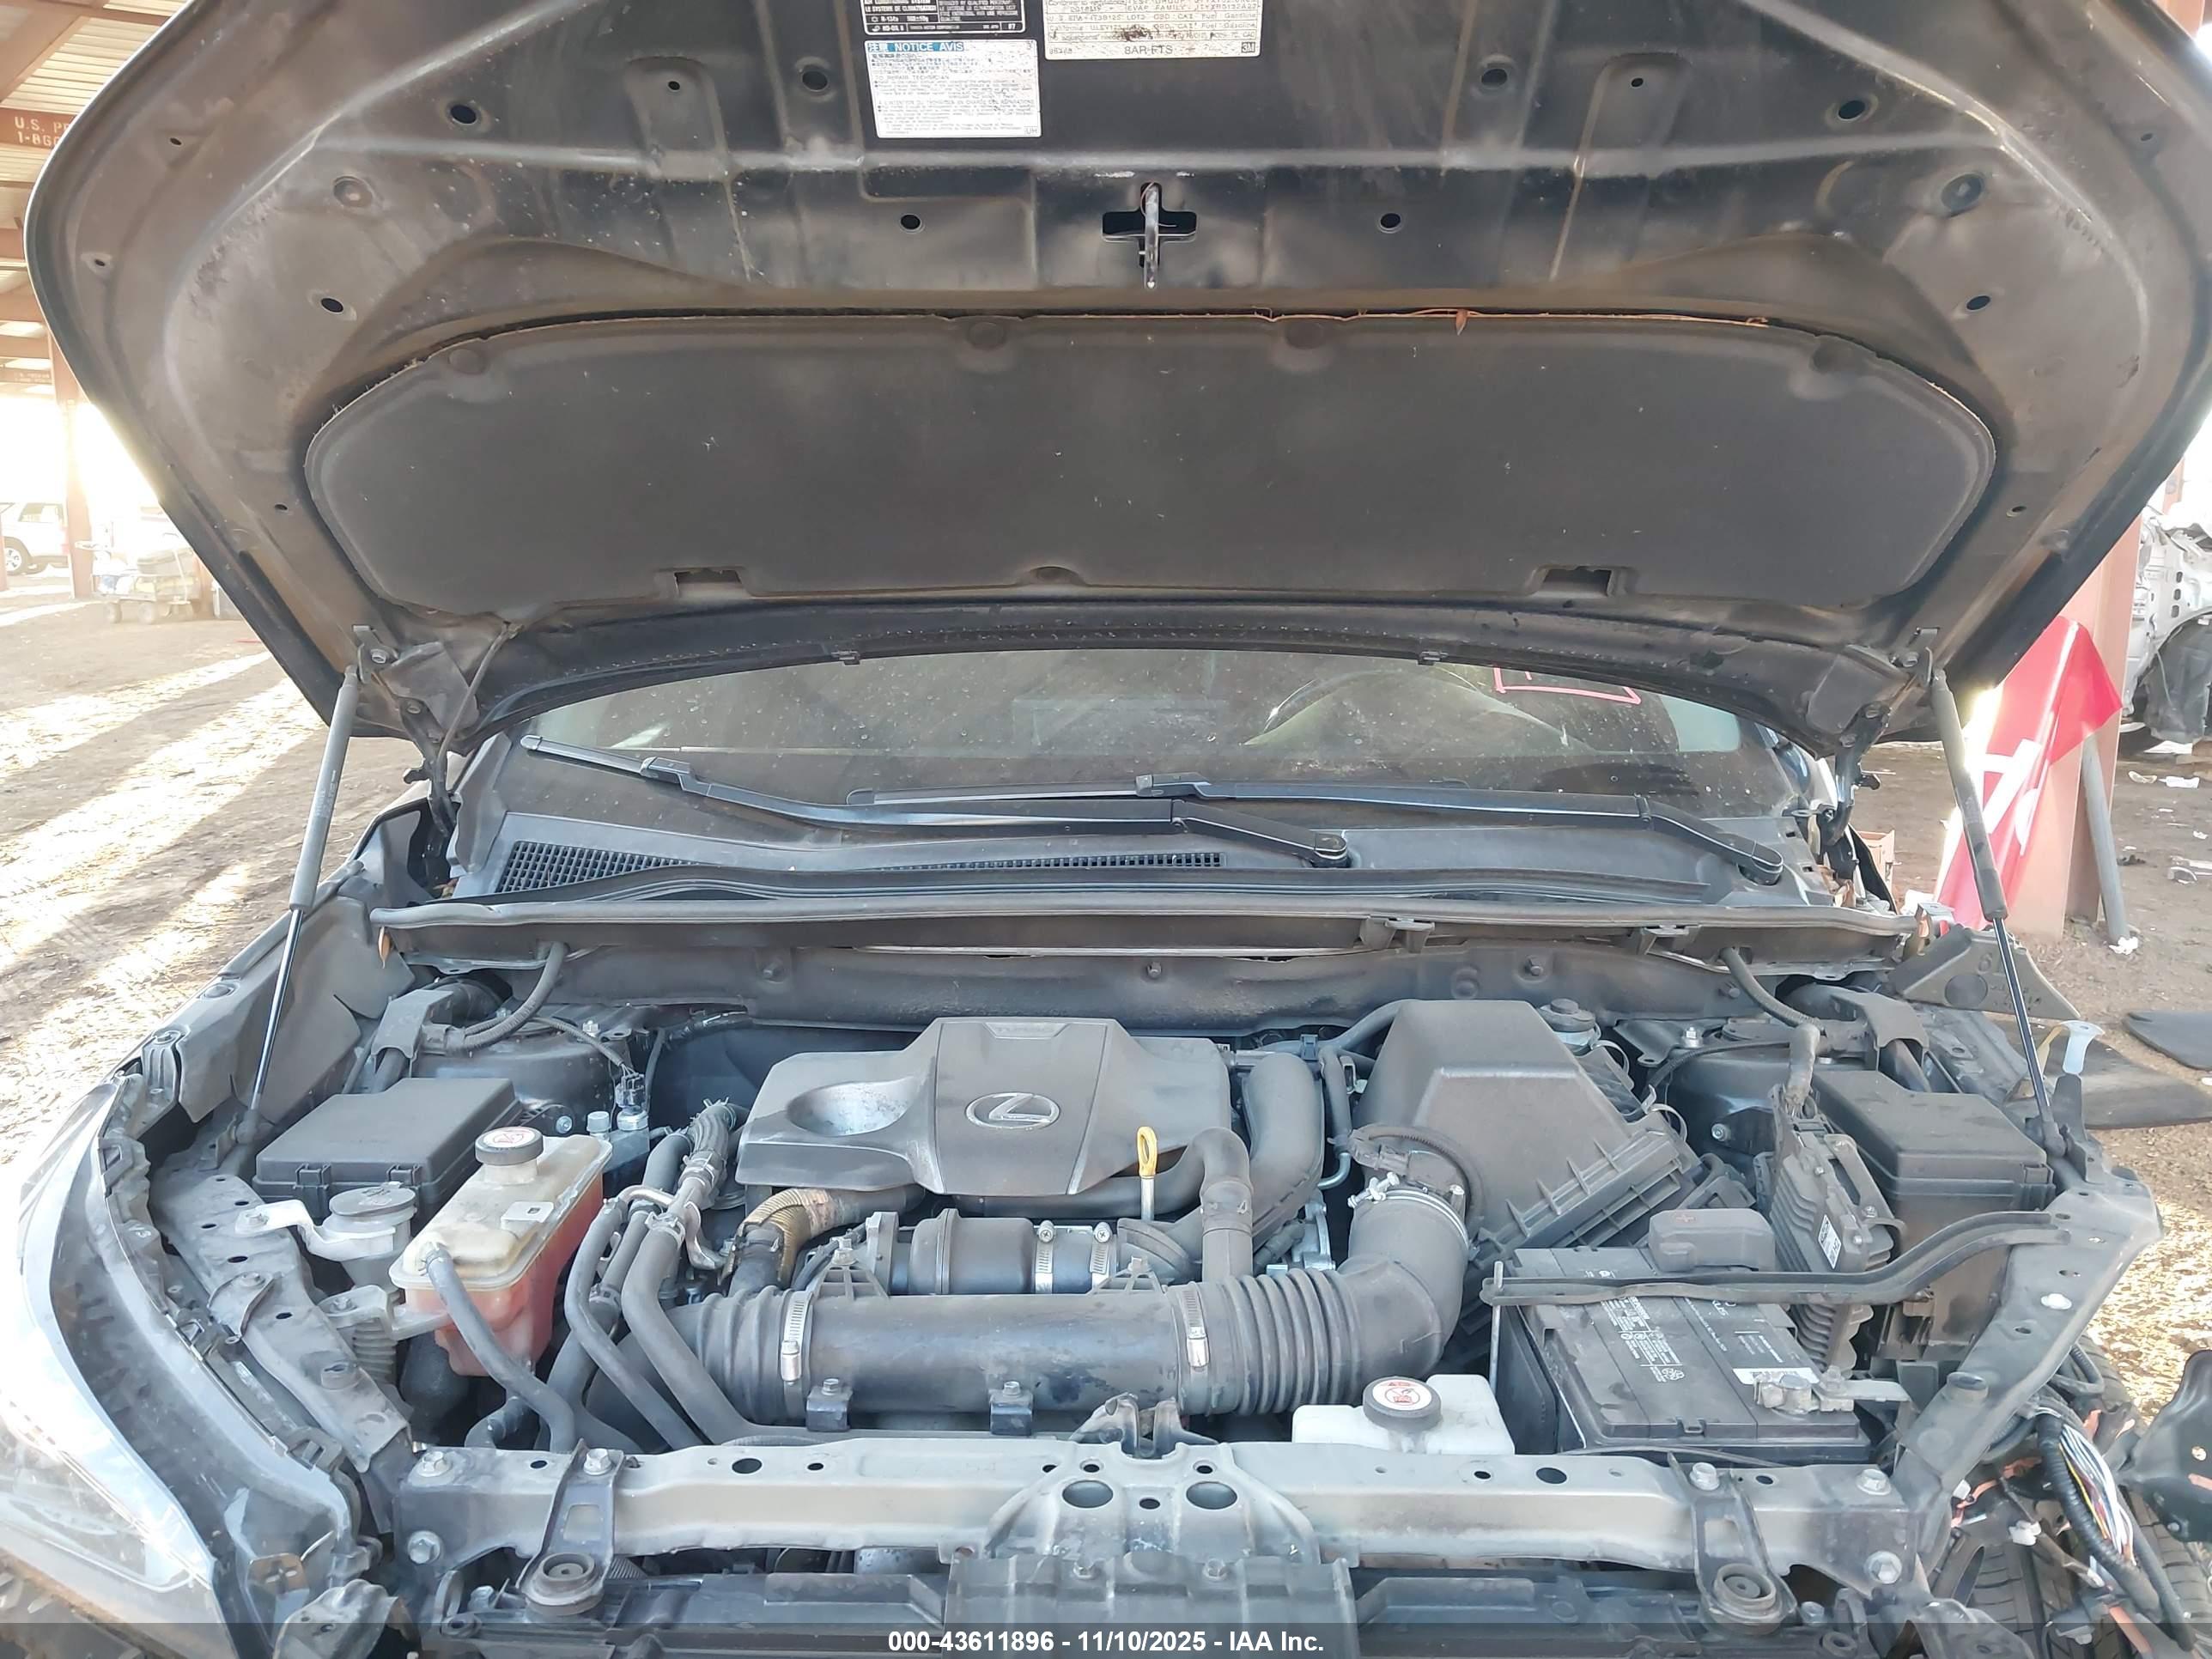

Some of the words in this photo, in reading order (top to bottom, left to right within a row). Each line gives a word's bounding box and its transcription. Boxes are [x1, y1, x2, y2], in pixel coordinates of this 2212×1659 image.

[895, 43, 933, 52] NOTICE
[939, 42, 964, 52] AVIS
[1124, 45, 1173, 55] 8AR-FTS
[1242, 42, 1255, 52] 3M
[15, 117, 45, 132] U.S.
